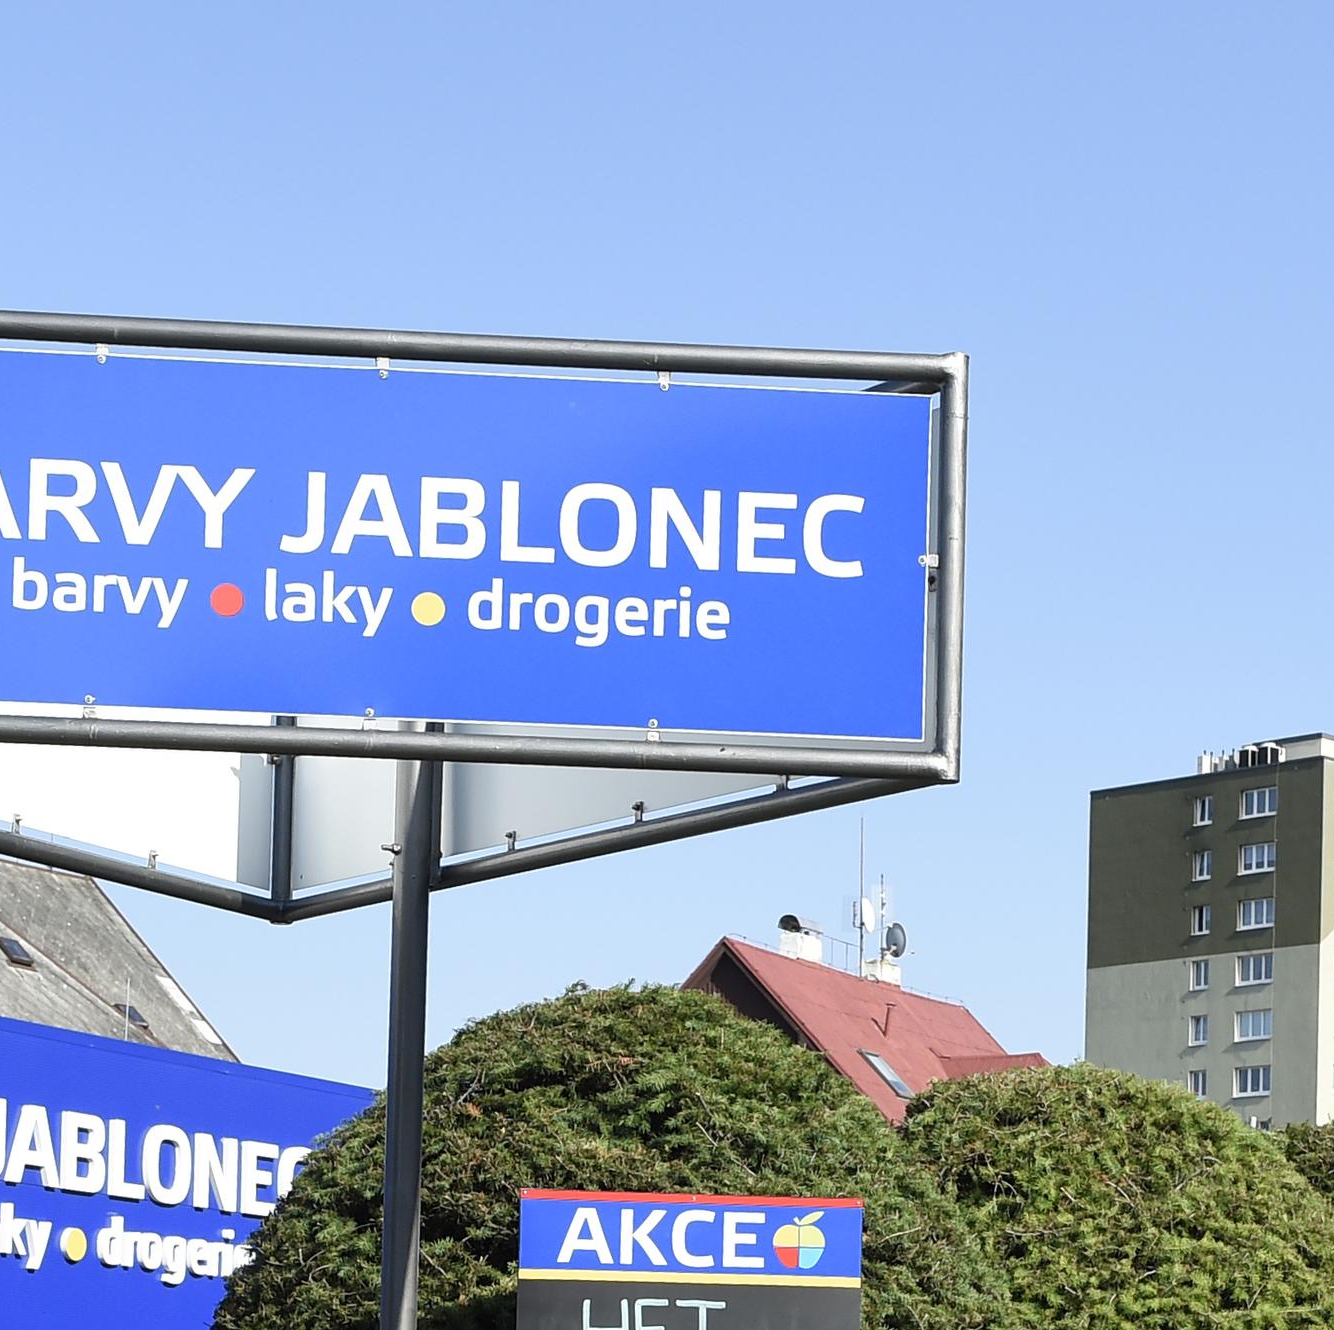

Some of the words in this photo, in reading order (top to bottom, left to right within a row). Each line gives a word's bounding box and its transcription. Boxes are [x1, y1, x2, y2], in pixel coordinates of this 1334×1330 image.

[279, 471, 865, 579] JABLONEC
[12, 555, 189, 629] barvy
[264, 567, 394, 638] laky
[467, 577, 731, 648] drogerie
[556, 1206, 767, 1269] AKCE
